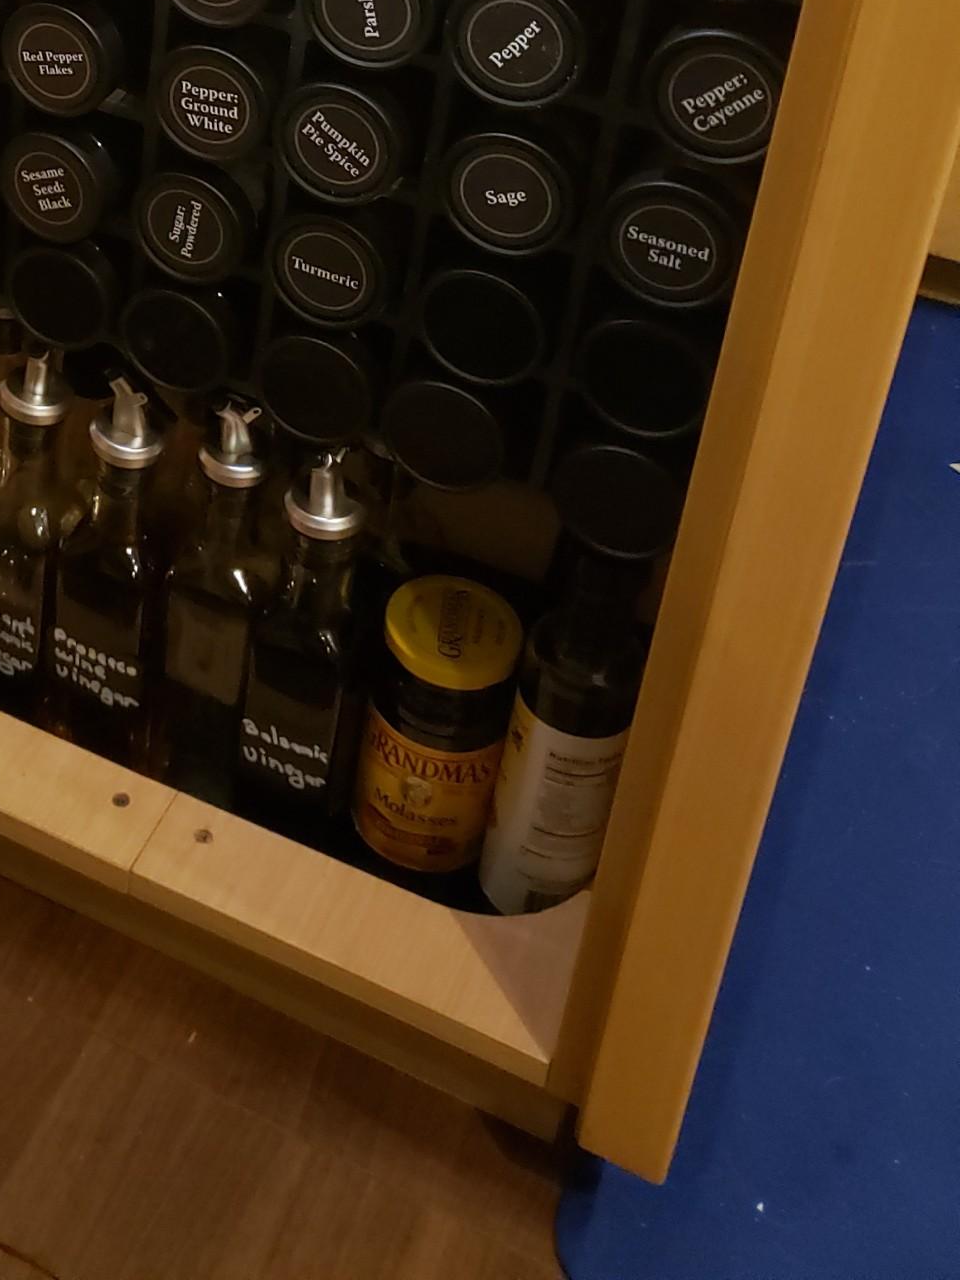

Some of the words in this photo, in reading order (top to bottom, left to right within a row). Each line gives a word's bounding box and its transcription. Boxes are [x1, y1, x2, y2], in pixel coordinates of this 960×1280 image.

[22, 51, 43, 62] Red
[45, 52, 83, 64] Pepper
[489, 20, 542, 68] Pepper
[39, 65, 73, 75] Flakes
[181, 80, 238, 104] Pepper:
[682, 73, 748, 114] Pepper:
[180, 97, 238, 120] Ground
[692, 87, 765, 132] Cayenne
[186, 113, 233, 134] White
[301, 123, 324, 146] Pie
[324, 143, 360, 177] Spice
[311, 111, 371, 168] Pumpkin
[21, 167, 64, 182] Sesame
[33, 183, 65, 196] Seed:
[38, 197, 72, 211] Black
[485, 188, 527, 207] Sage
[169, 205, 186, 243] Sugar:
[181, 200, 202, 258] Powdered
[627, 226, 710, 261] Seasoned
[292, 256, 359, 290] Turmeric
[647, 249, 682, 270] Salt
[242, 718, 329, 765] Balsamic
